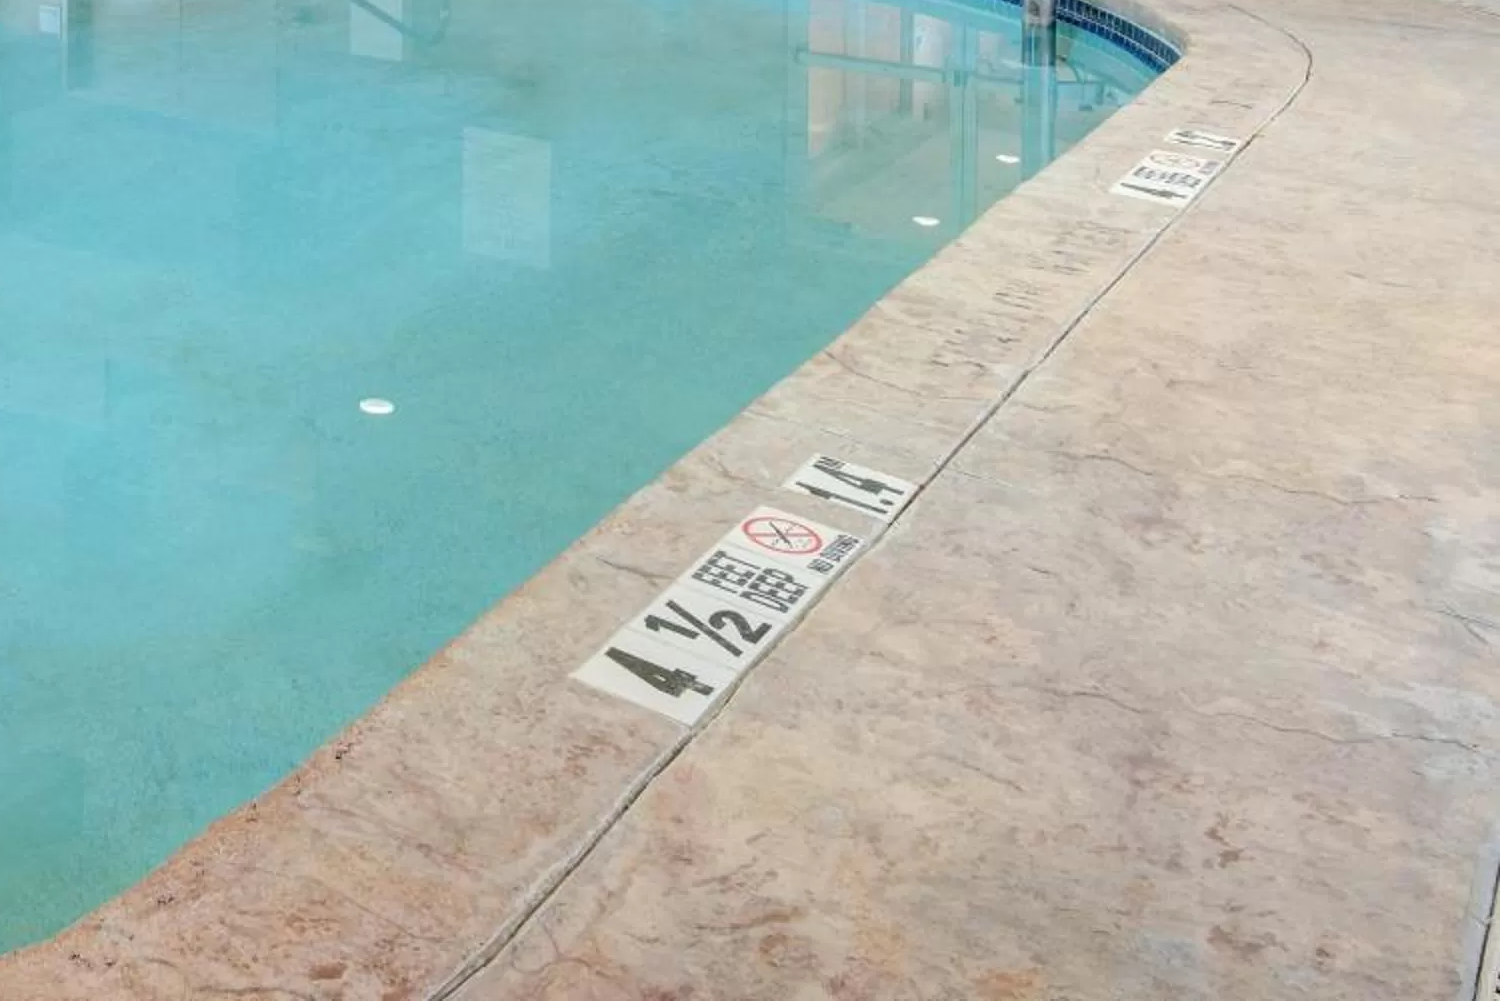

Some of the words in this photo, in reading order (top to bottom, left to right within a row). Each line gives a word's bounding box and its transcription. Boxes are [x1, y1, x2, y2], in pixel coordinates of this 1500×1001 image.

[795, 462, 905, 514] 1.4
[691, 550, 761, 594] FEET
[740, 568, 809, 613] DEEP
[644, 600, 772, 657] 1/2
[604, 646, 715, 698] 4
